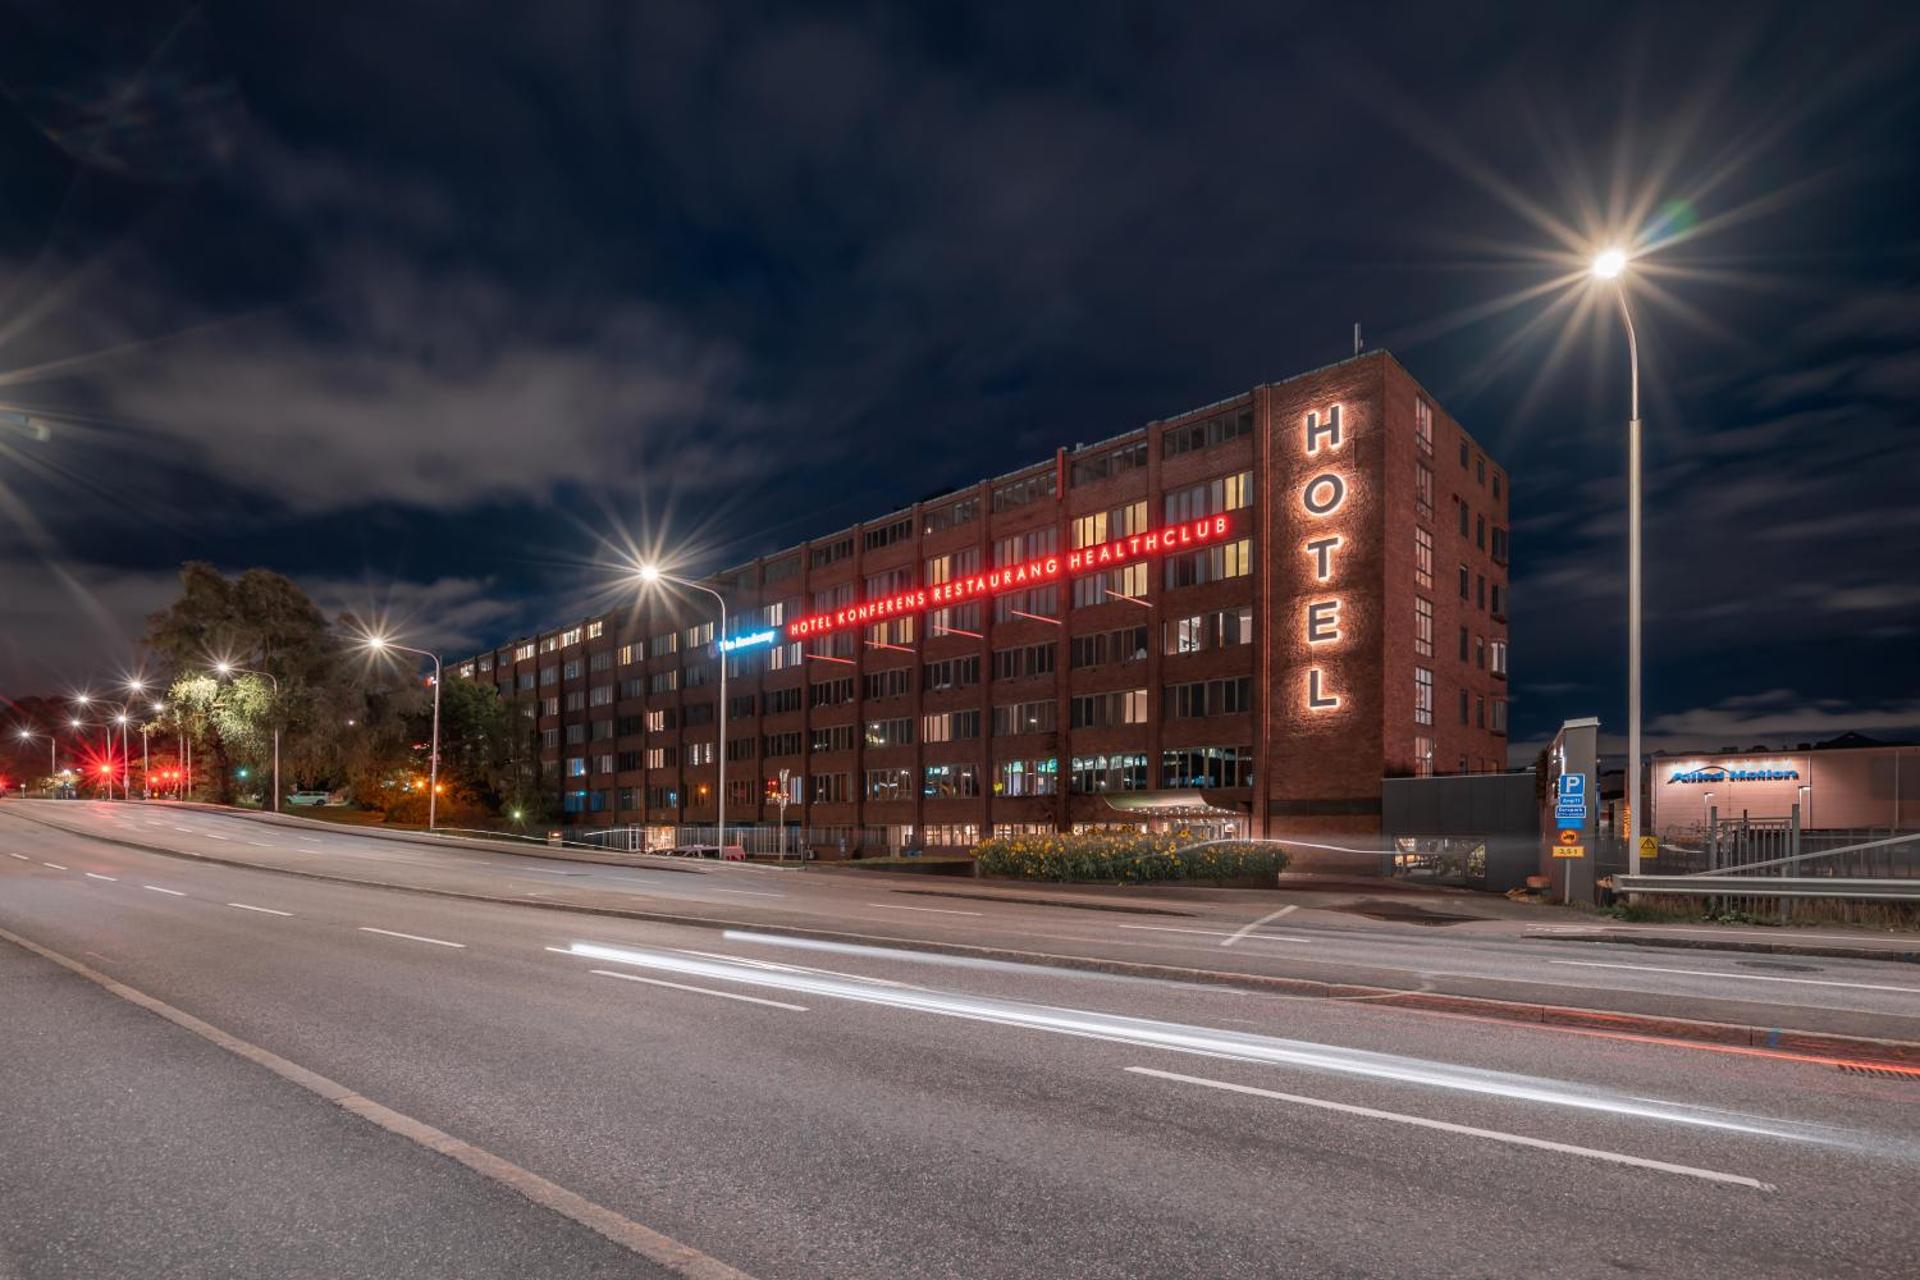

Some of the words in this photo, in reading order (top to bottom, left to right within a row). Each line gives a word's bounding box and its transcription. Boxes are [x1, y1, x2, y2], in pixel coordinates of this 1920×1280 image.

[791, 616, 831, 635] HOTEL
[838, 593, 925, 625] KONFERENS
[934, 559, 1057, 602] RESTAURANG
[1070, 517, 1226, 569] HEALTHCLUB
[1303, 405, 1345, 708] HOTEL
[1566, 776, 1580, 793] P
[1729, 769, 1799, 782] Motion
